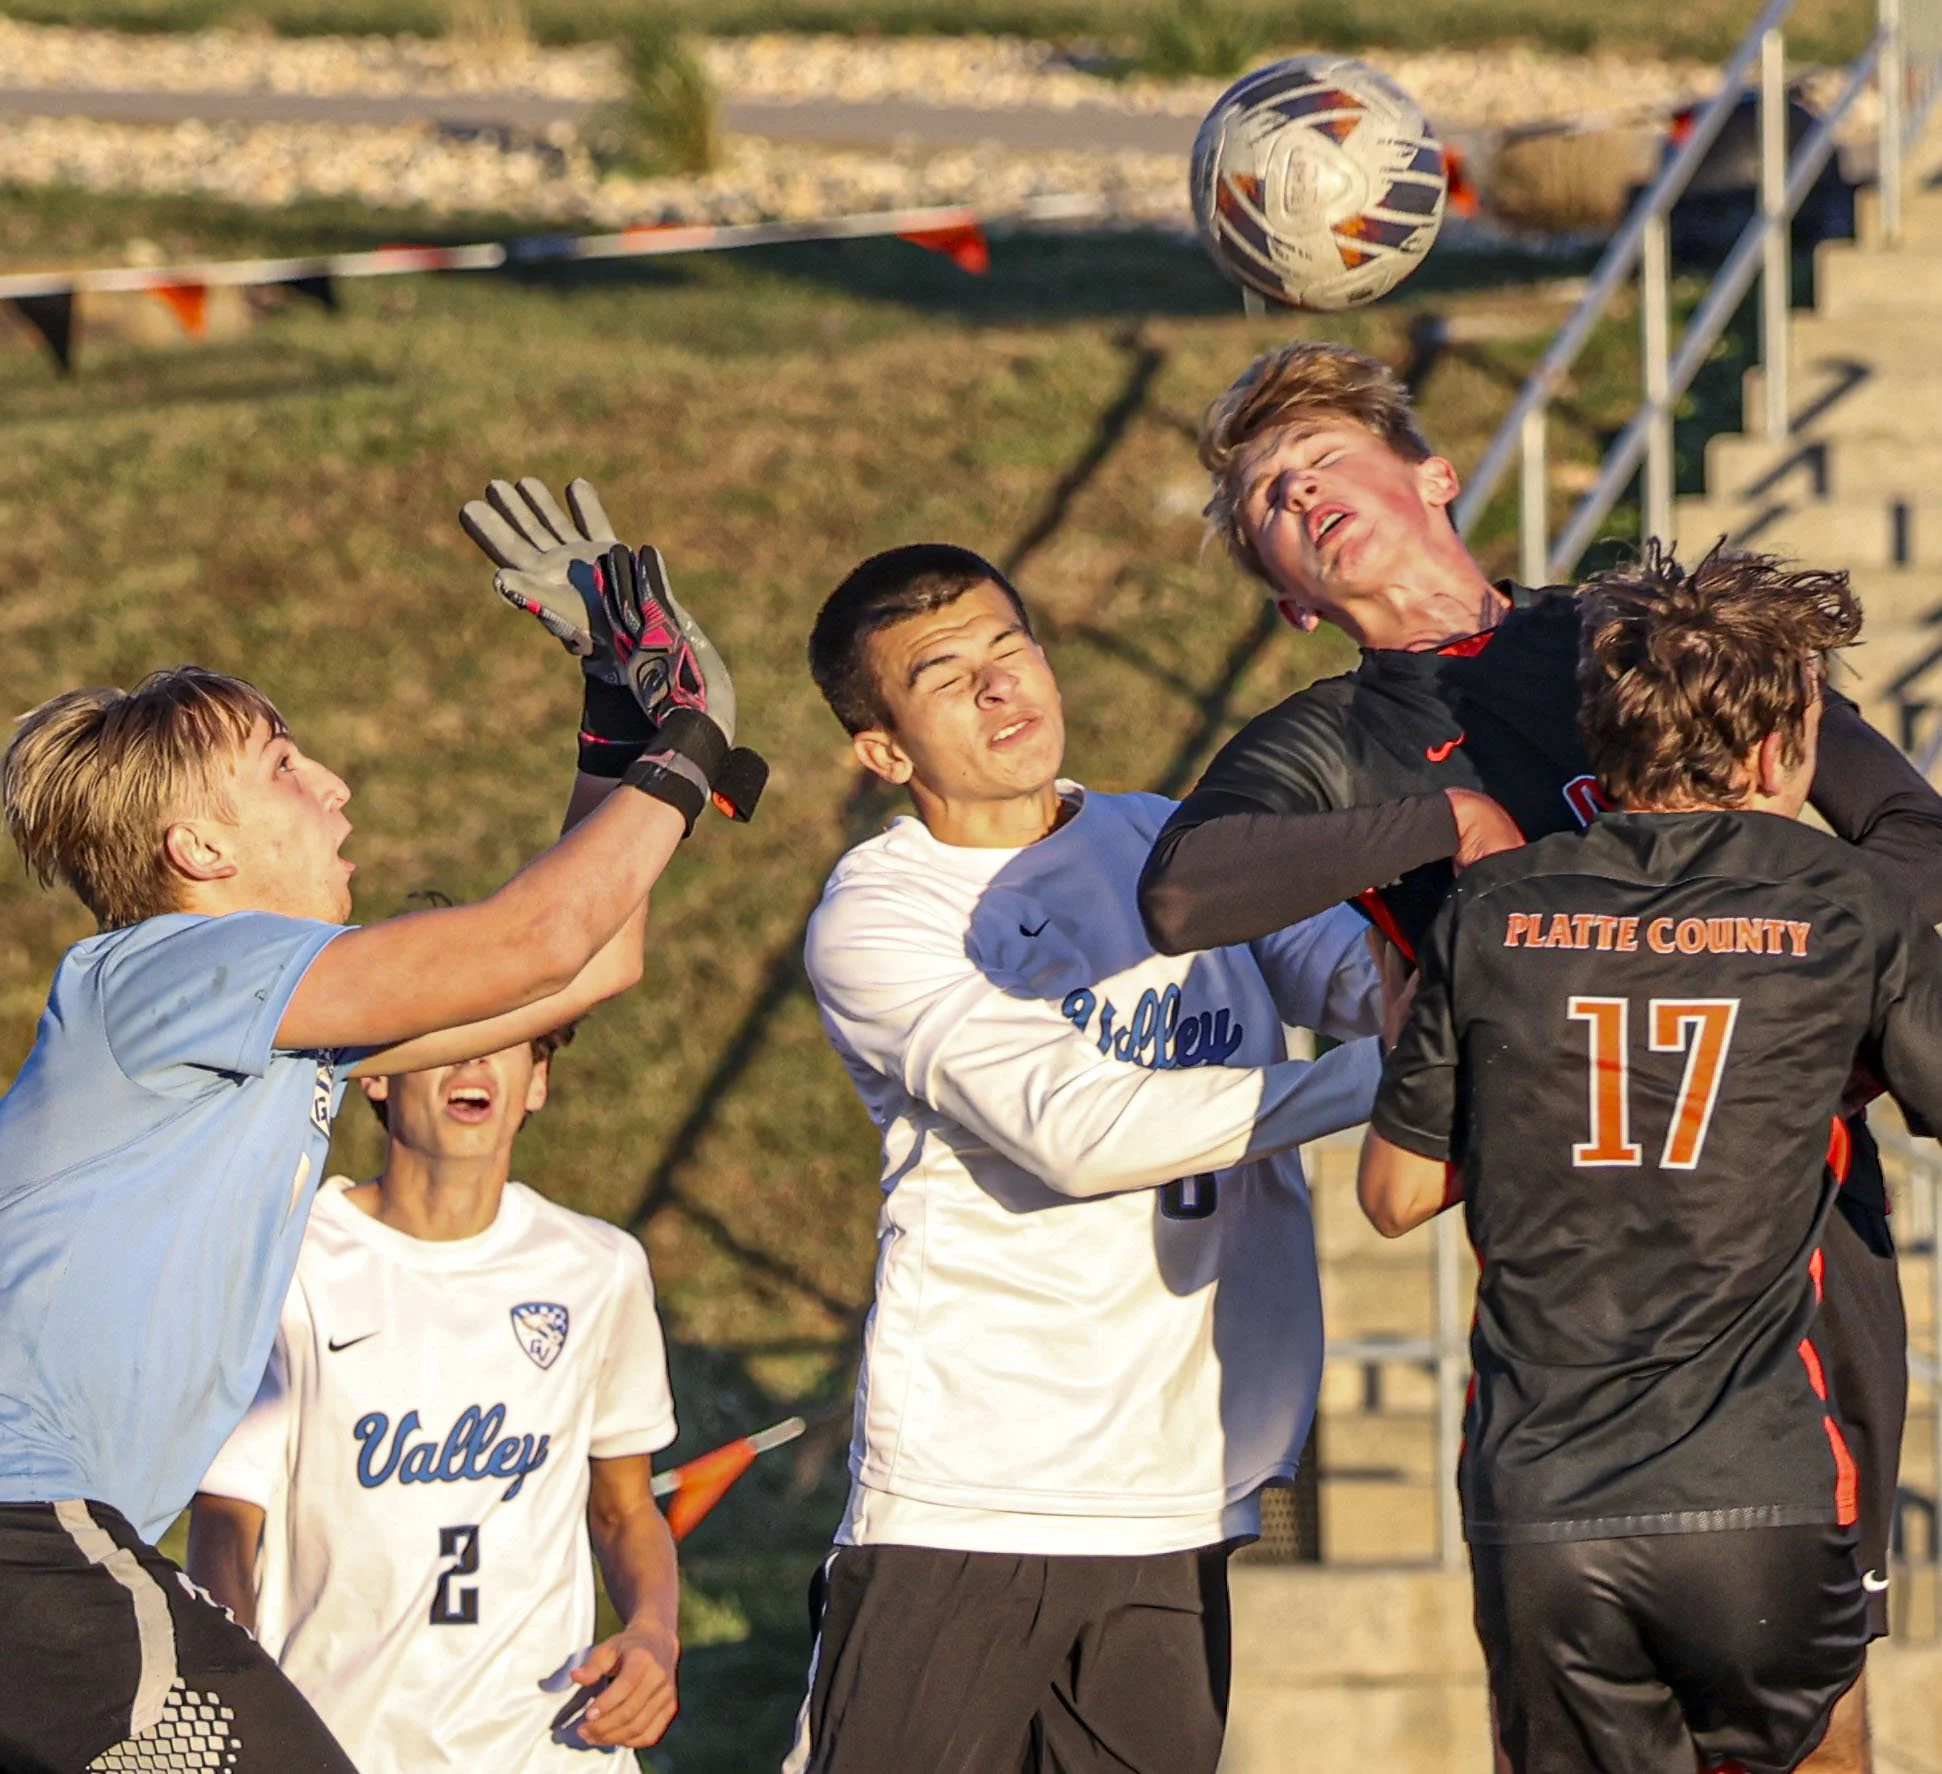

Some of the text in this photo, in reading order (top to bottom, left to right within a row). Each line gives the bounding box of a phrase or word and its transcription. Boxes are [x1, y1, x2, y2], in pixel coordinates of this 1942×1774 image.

[1503, 912, 1812, 957] PLATTE COUNTY
[1566, 995, 1742, 1170] 17
[353, 1402, 551, 1502] Valley
[429, 1524, 480, 1626] 2
